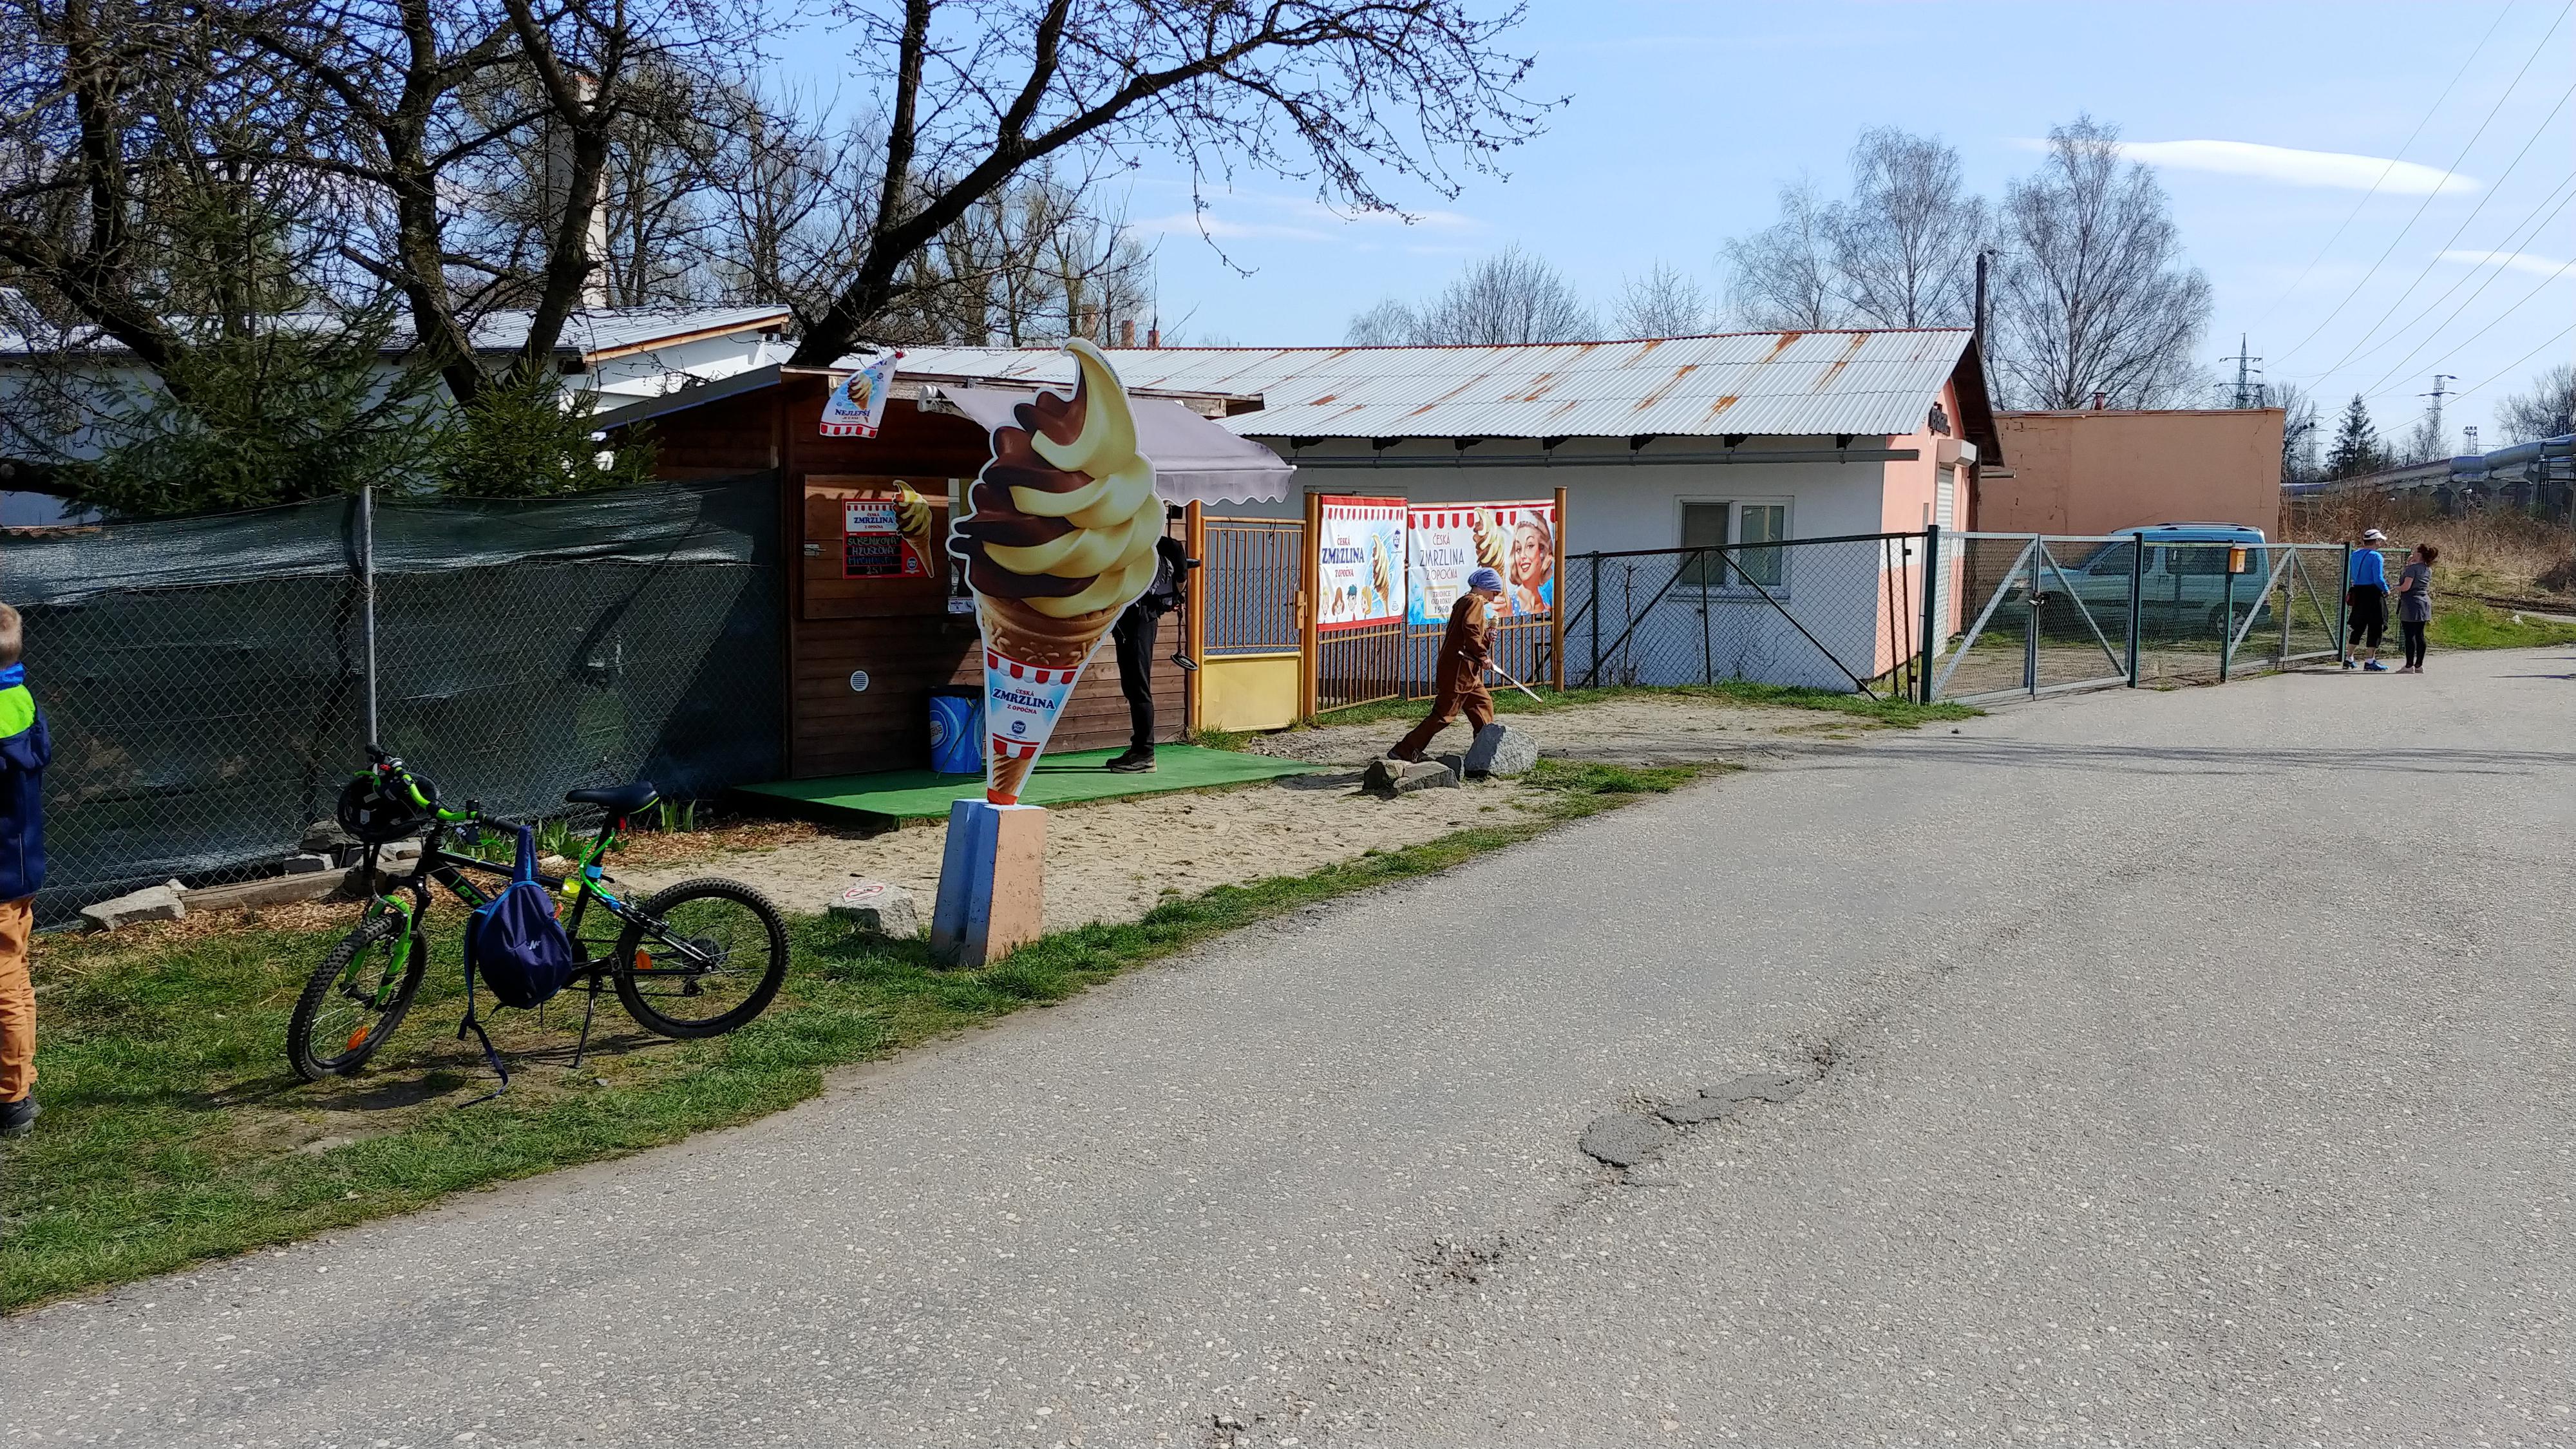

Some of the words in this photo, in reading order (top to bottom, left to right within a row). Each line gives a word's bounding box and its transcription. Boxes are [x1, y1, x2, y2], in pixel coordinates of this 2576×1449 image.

[1337, 535, 1350, 545] ČESKÁ
[1432, 532, 1450, 545] ČESKÁ
[1322, 547, 1365, 564] ZMRZLINA
[1419, 548, 1464, 567] ZMRZLINA
[1426, 573, 1430, 581] Z
[1431, 567, 1457, 580] OPOČNA
[992, 688, 1055, 709] ZMRZLINA
[1016, 687, 1034, 696] ČESKÁ
